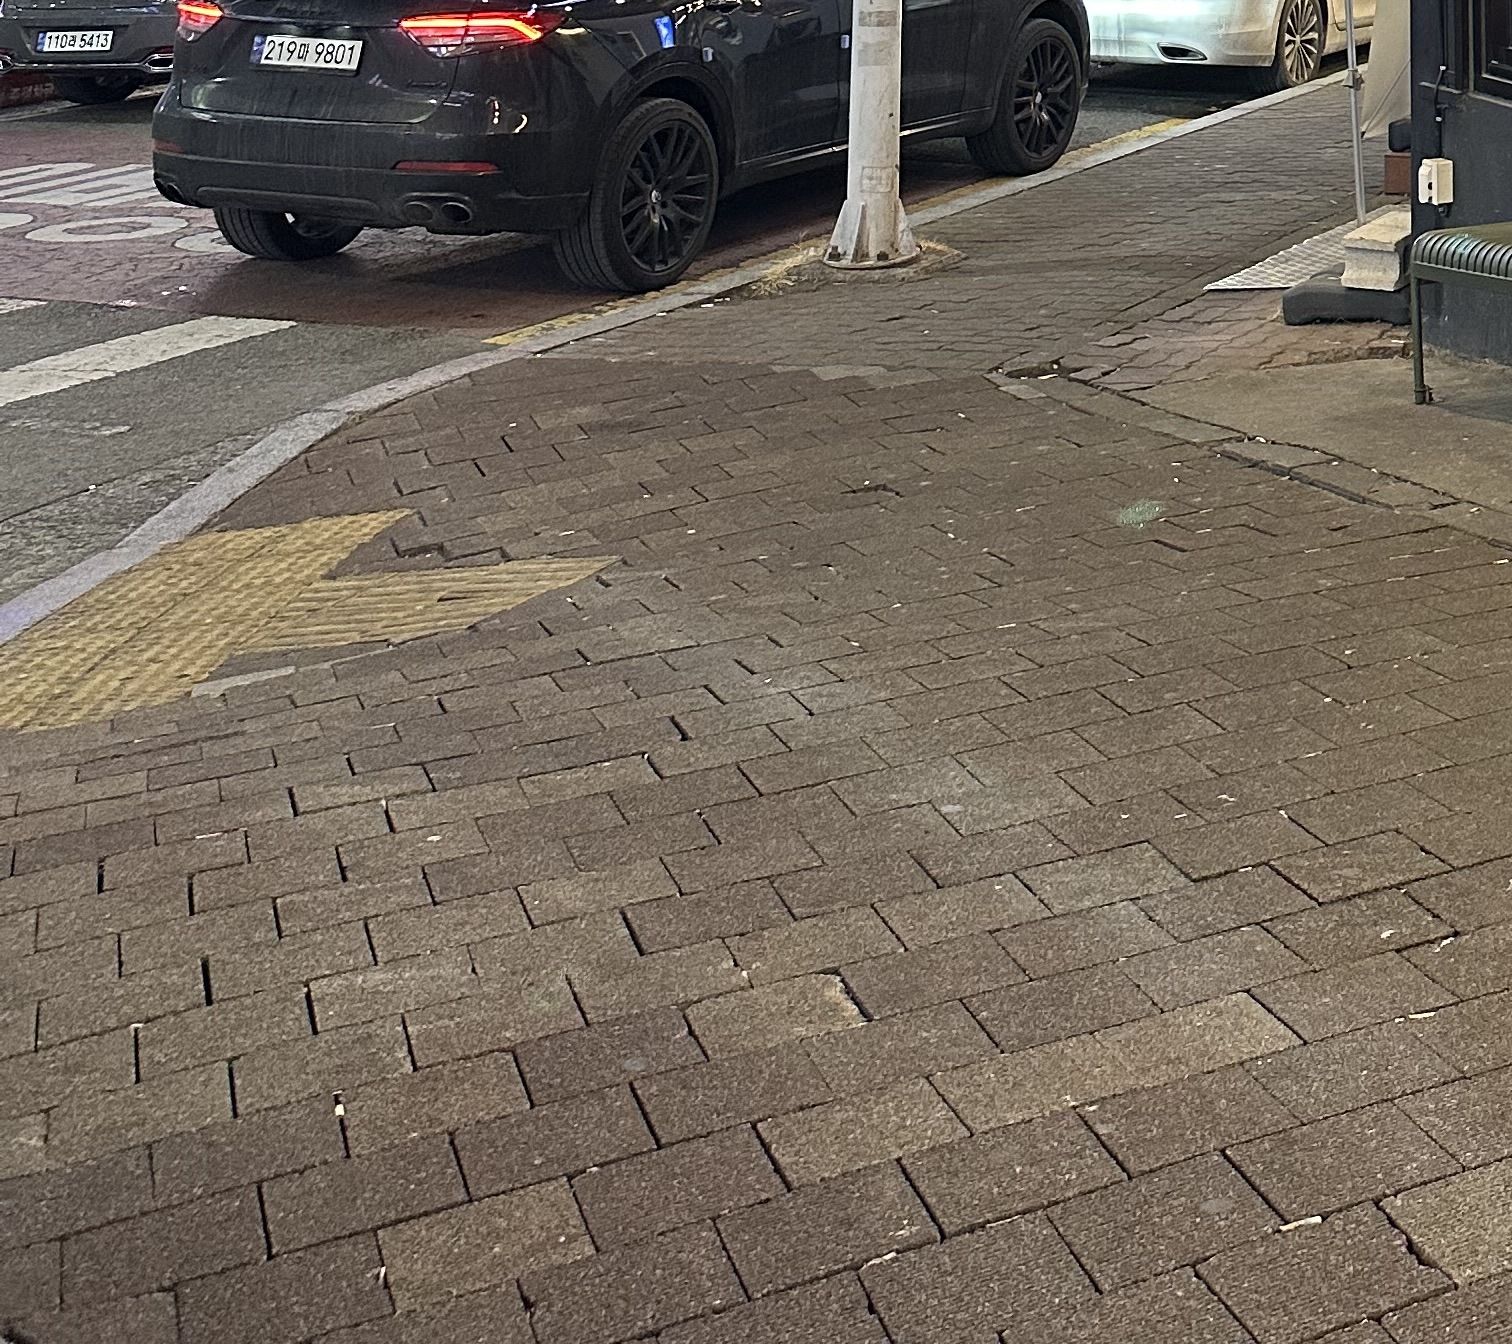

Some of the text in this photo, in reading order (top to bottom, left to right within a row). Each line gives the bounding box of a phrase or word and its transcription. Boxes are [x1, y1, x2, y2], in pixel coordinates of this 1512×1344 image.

[79, 32, 110, 49] 5413
[264, 41, 355, 65] 219마 9801
